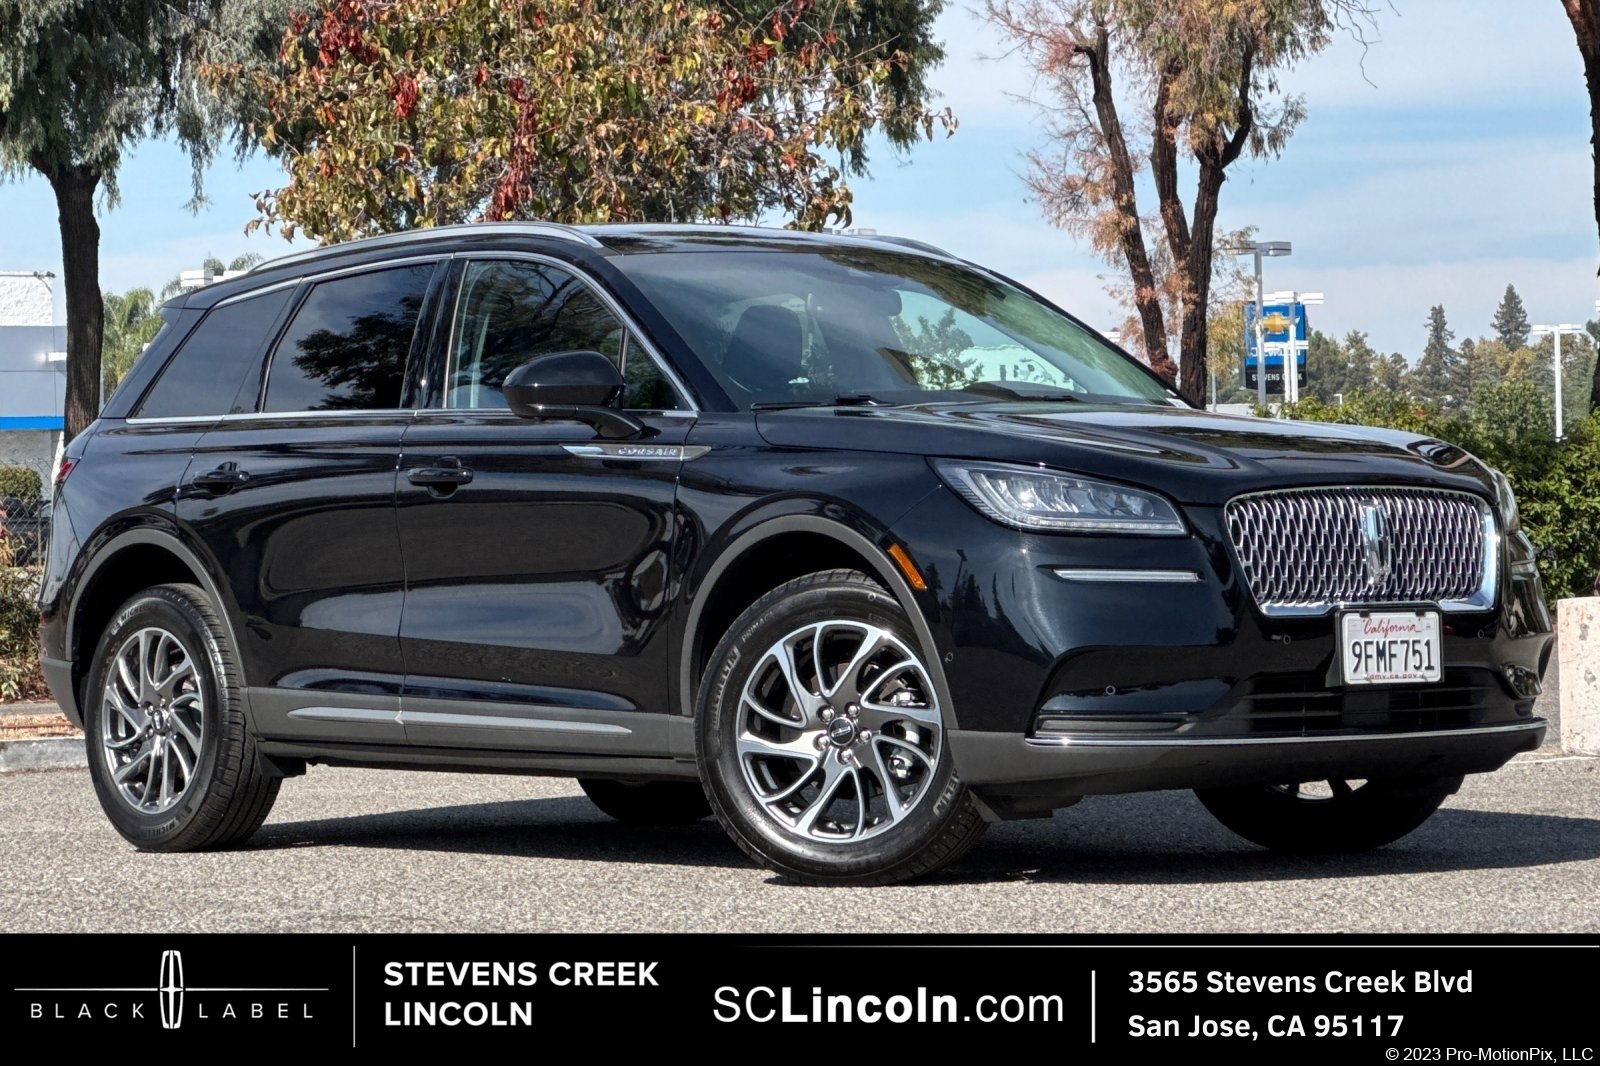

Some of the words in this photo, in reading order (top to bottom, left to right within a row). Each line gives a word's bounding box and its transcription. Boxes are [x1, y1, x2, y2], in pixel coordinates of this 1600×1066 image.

[618, 447, 677, 456] CORSAIR
[1363, 618, 1422, 638] California
[1352, 640, 1435, 673] 9FMF751
